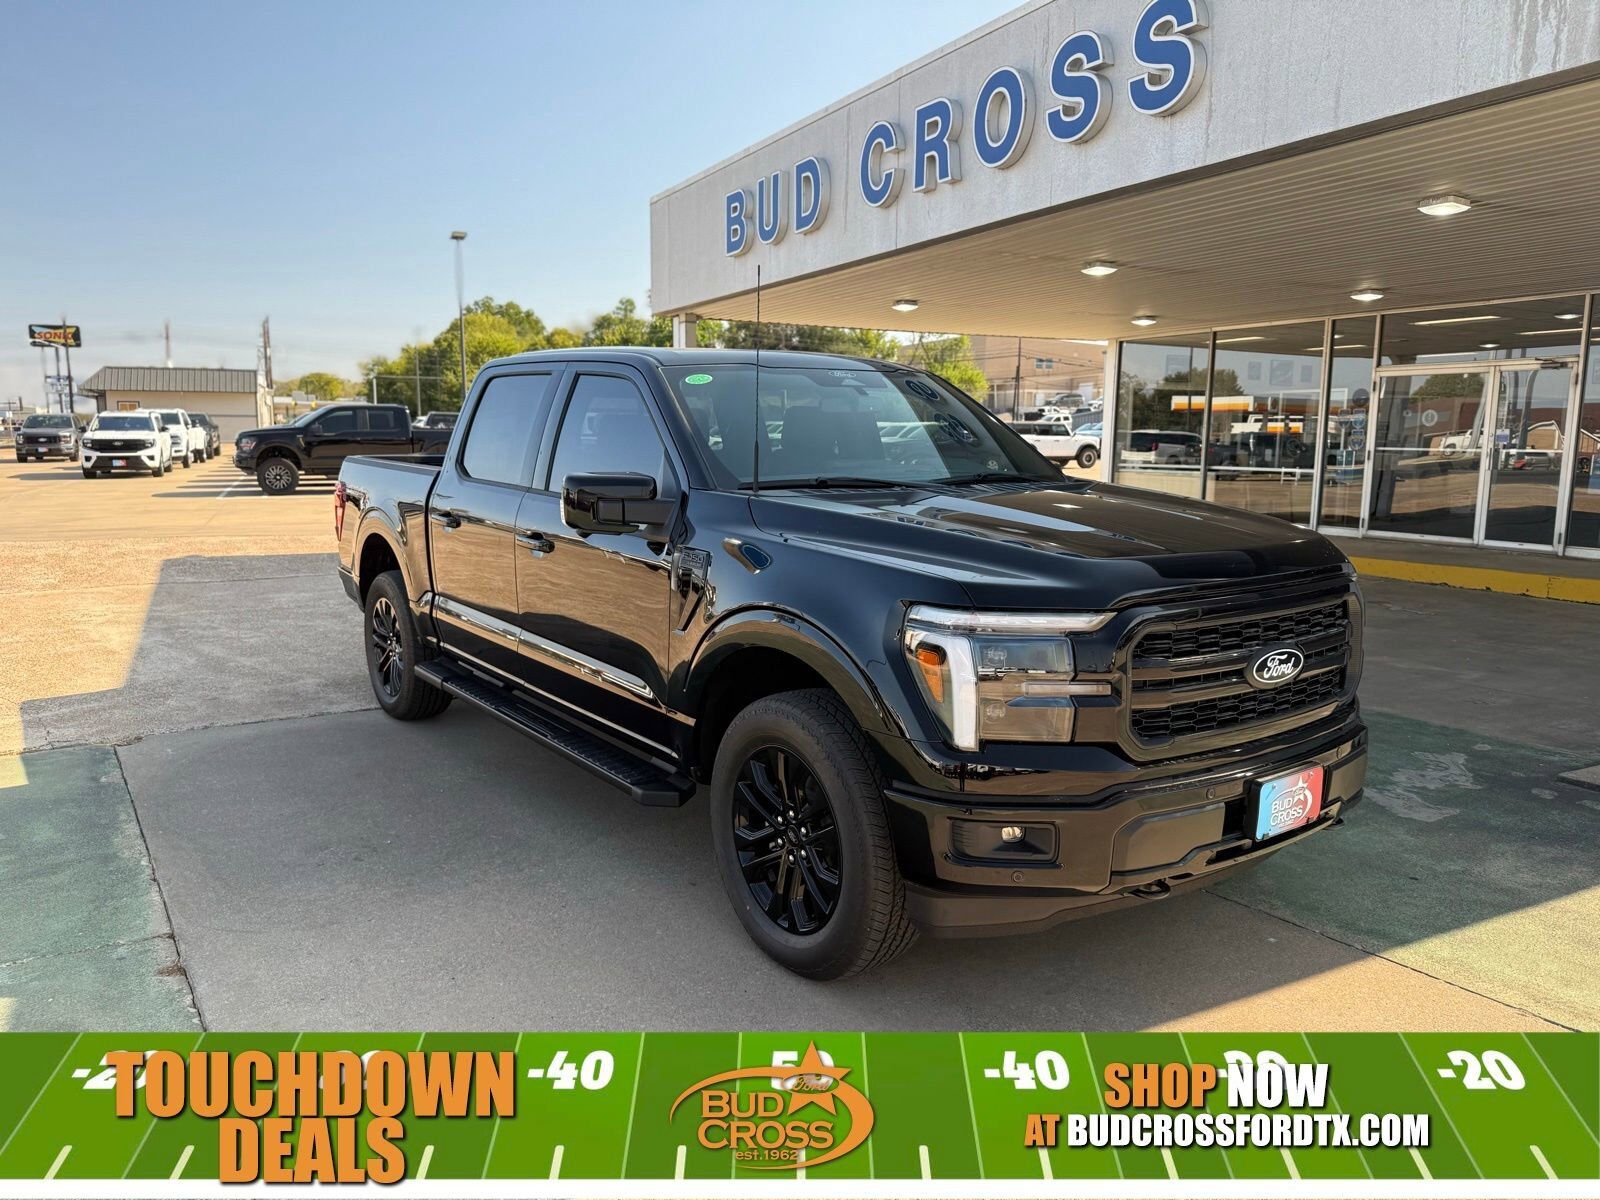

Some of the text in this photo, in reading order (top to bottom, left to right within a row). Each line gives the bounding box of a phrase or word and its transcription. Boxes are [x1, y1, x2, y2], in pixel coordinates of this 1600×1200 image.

[725, 0, 1206, 257] BUD CROSS
[1263, 653, 1296, 679] Ford
[1270, 806, 1303, 826] CROSS
[1271, 797, 1293, 813] BUD
